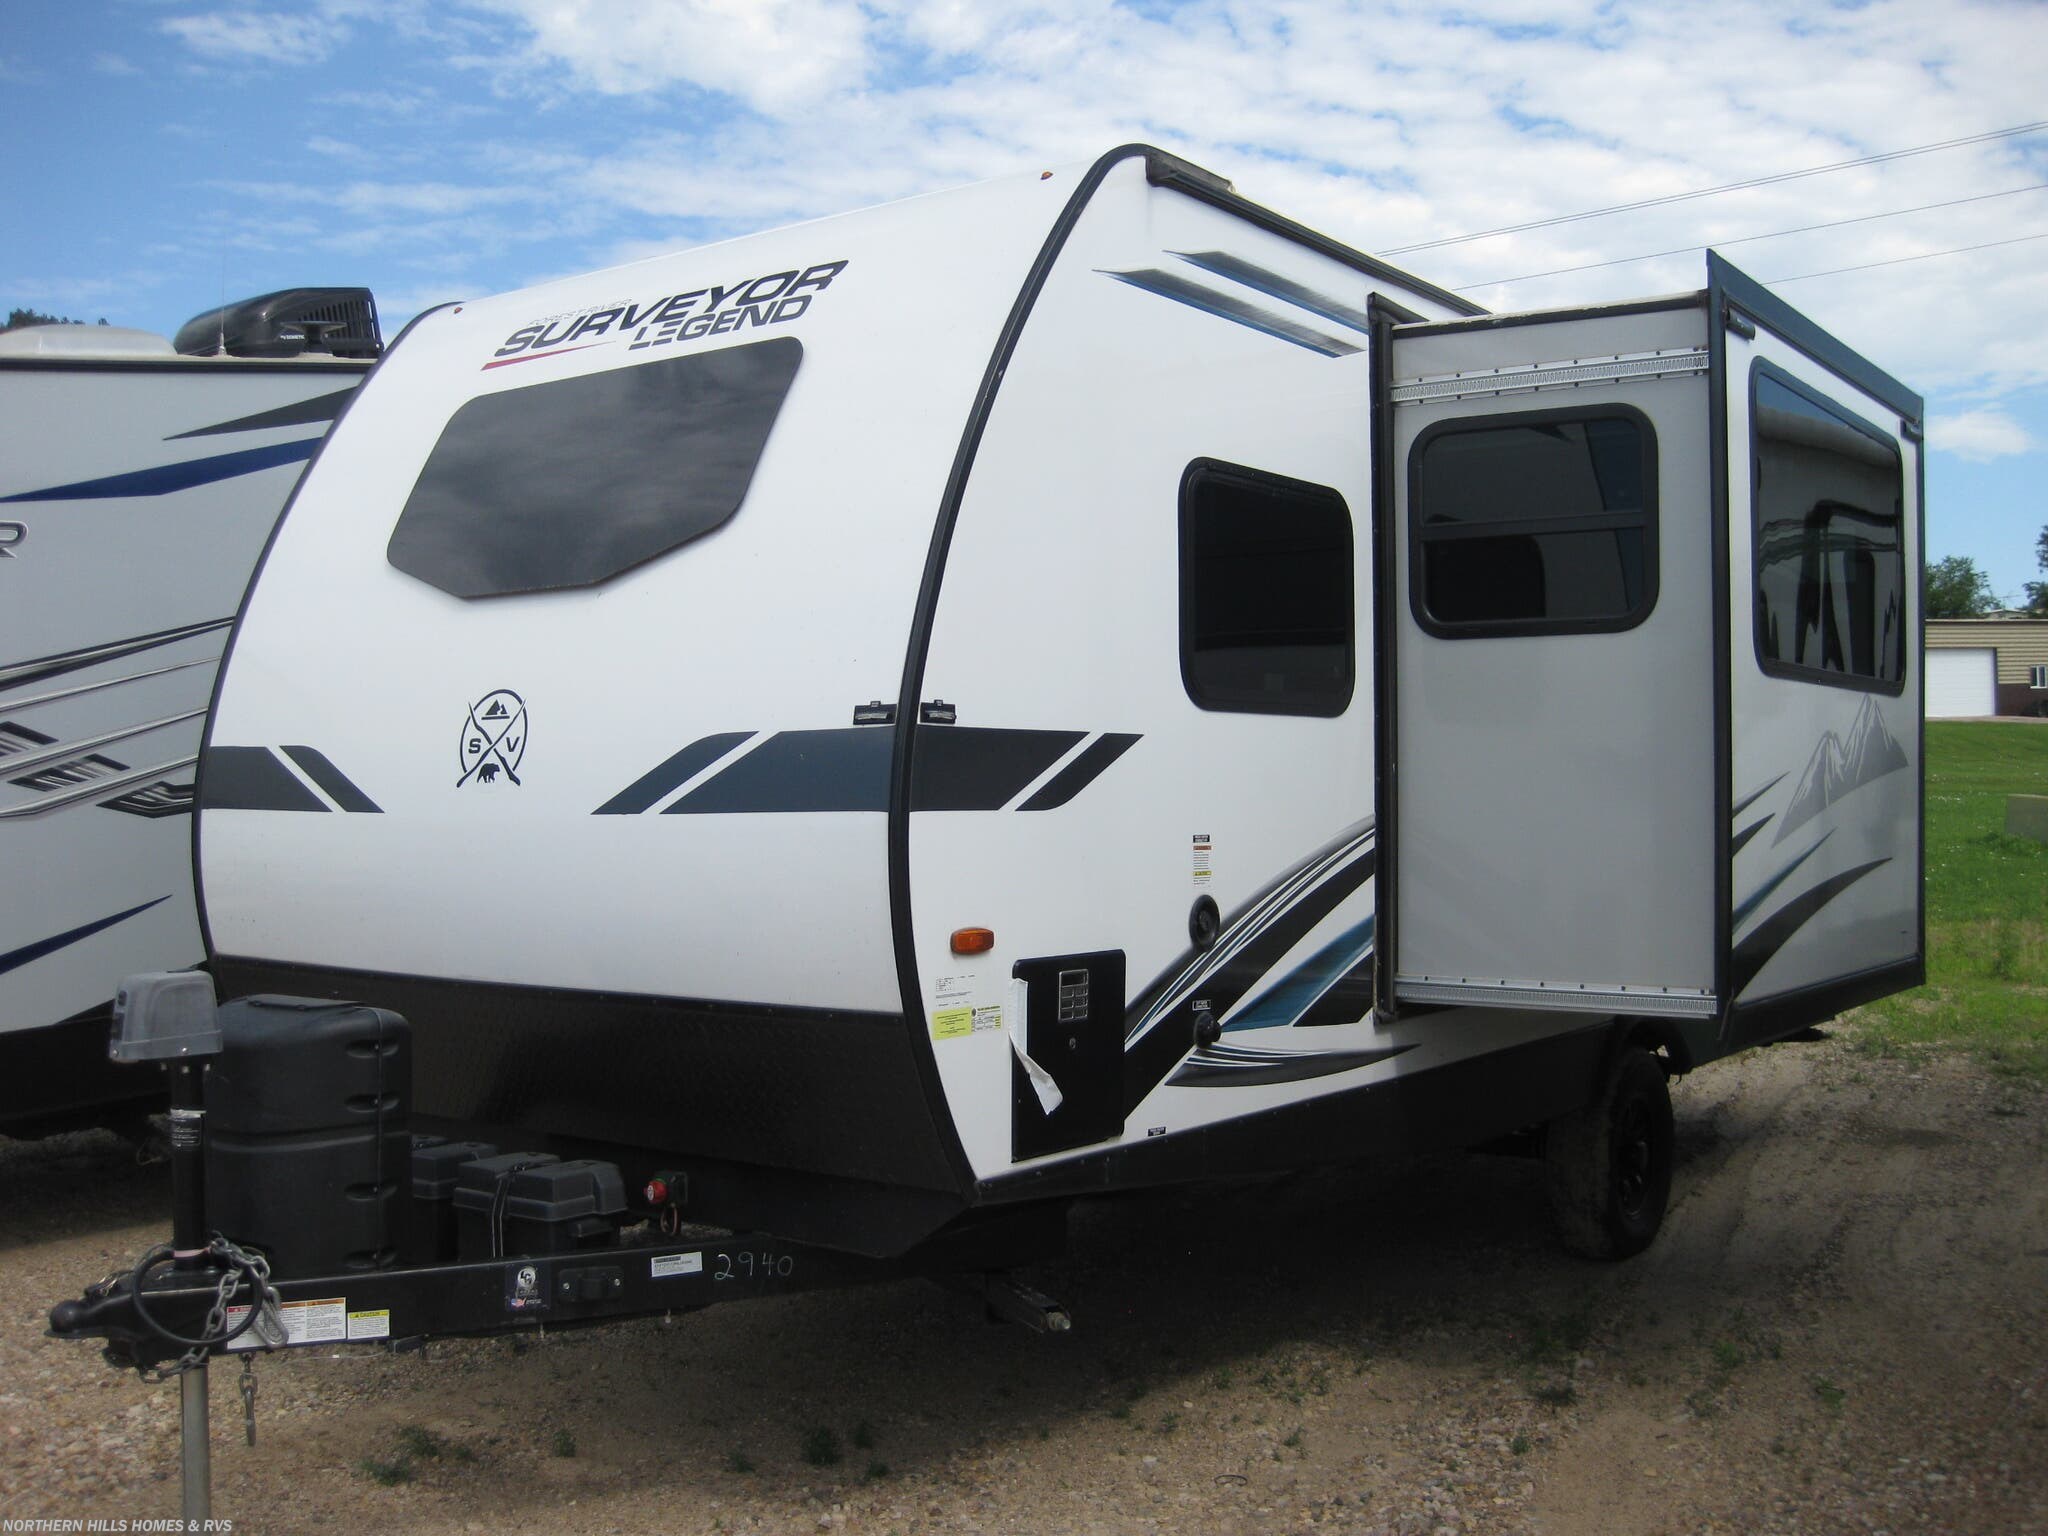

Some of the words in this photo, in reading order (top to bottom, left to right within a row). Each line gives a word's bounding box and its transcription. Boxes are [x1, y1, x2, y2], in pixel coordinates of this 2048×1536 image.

[494, 260, 849, 357] SURVEYOR
[628, 294, 813, 351] LEGEND
[714, 1251, 793, 1280] 2940
